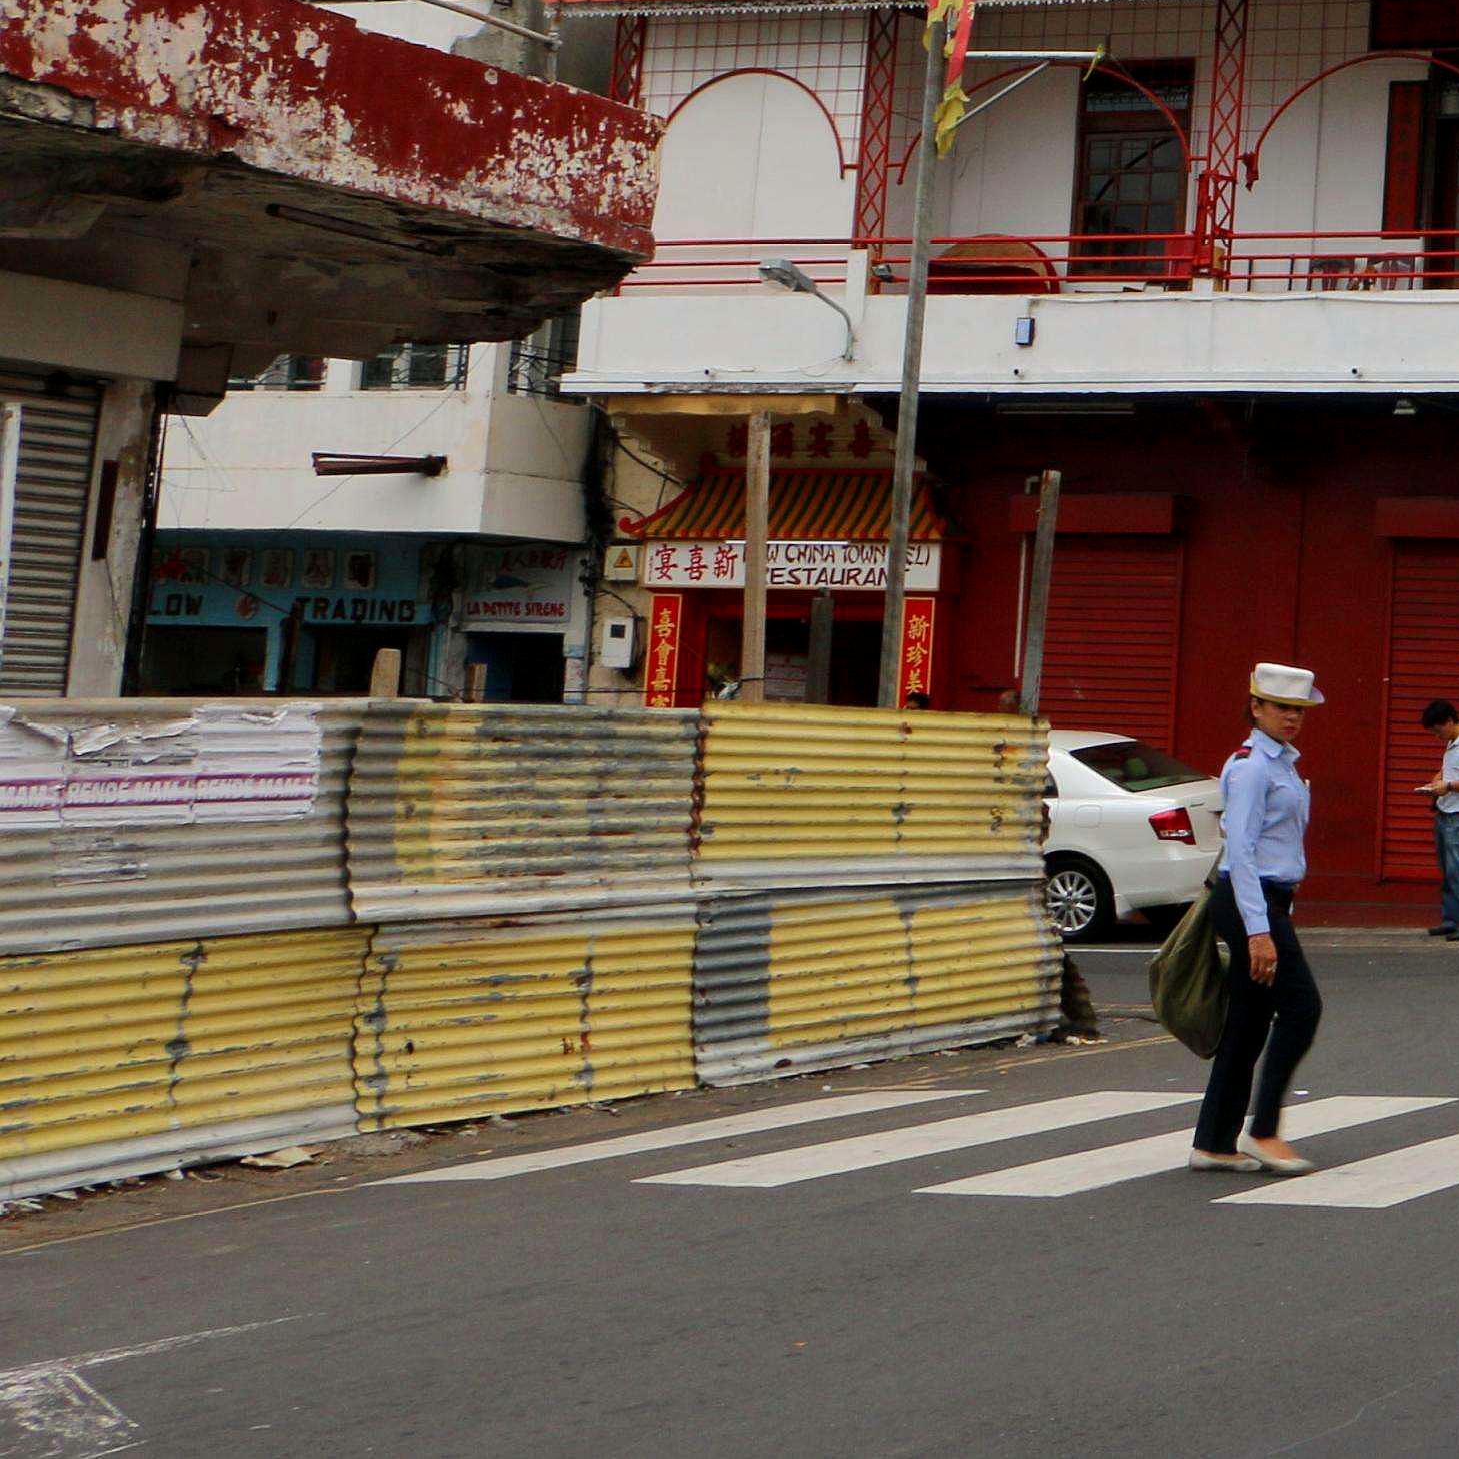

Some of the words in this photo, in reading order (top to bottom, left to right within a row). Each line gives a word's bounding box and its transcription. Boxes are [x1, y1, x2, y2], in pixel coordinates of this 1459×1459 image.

[785, 542, 835, 564] CHINA
[842, 542, 886, 564] TOWN
[767, 567, 909, 585] ESTAURAN
[904, 614, 930, 695] 新珍美
